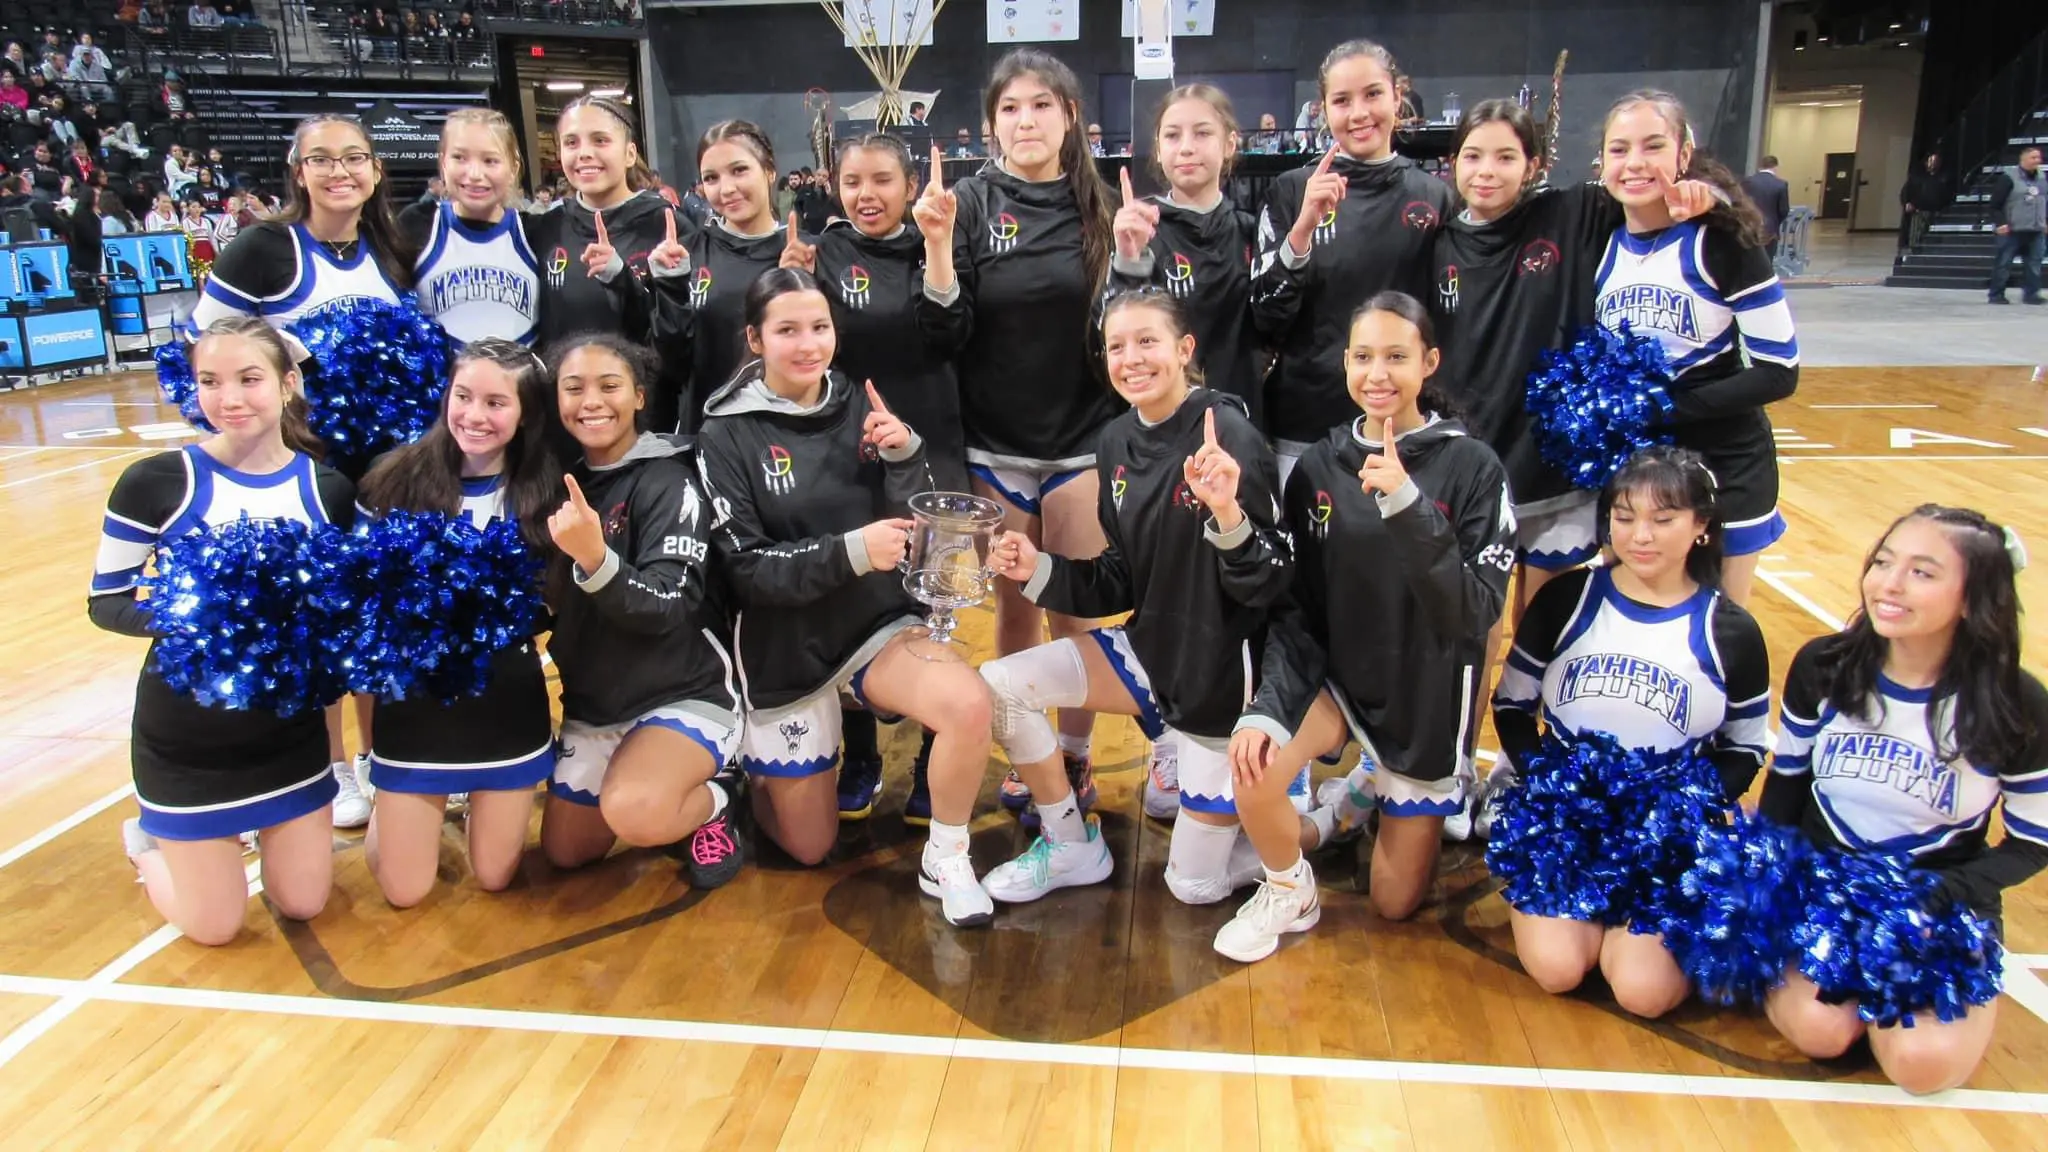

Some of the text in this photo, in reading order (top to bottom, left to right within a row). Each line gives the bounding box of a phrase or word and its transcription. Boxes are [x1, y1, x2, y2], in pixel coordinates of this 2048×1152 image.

[430, 264, 532, 320] MAHPIYA
[32, 328, 96, 346] POWERADE
[1556, 653, 1692, 736] MAHPIYA
[1573, 675, 1679, 719] LUTA
[1815, 732, 1962, 821] MAHPIYA
[1832, 757, 1937, 810] LUTA
